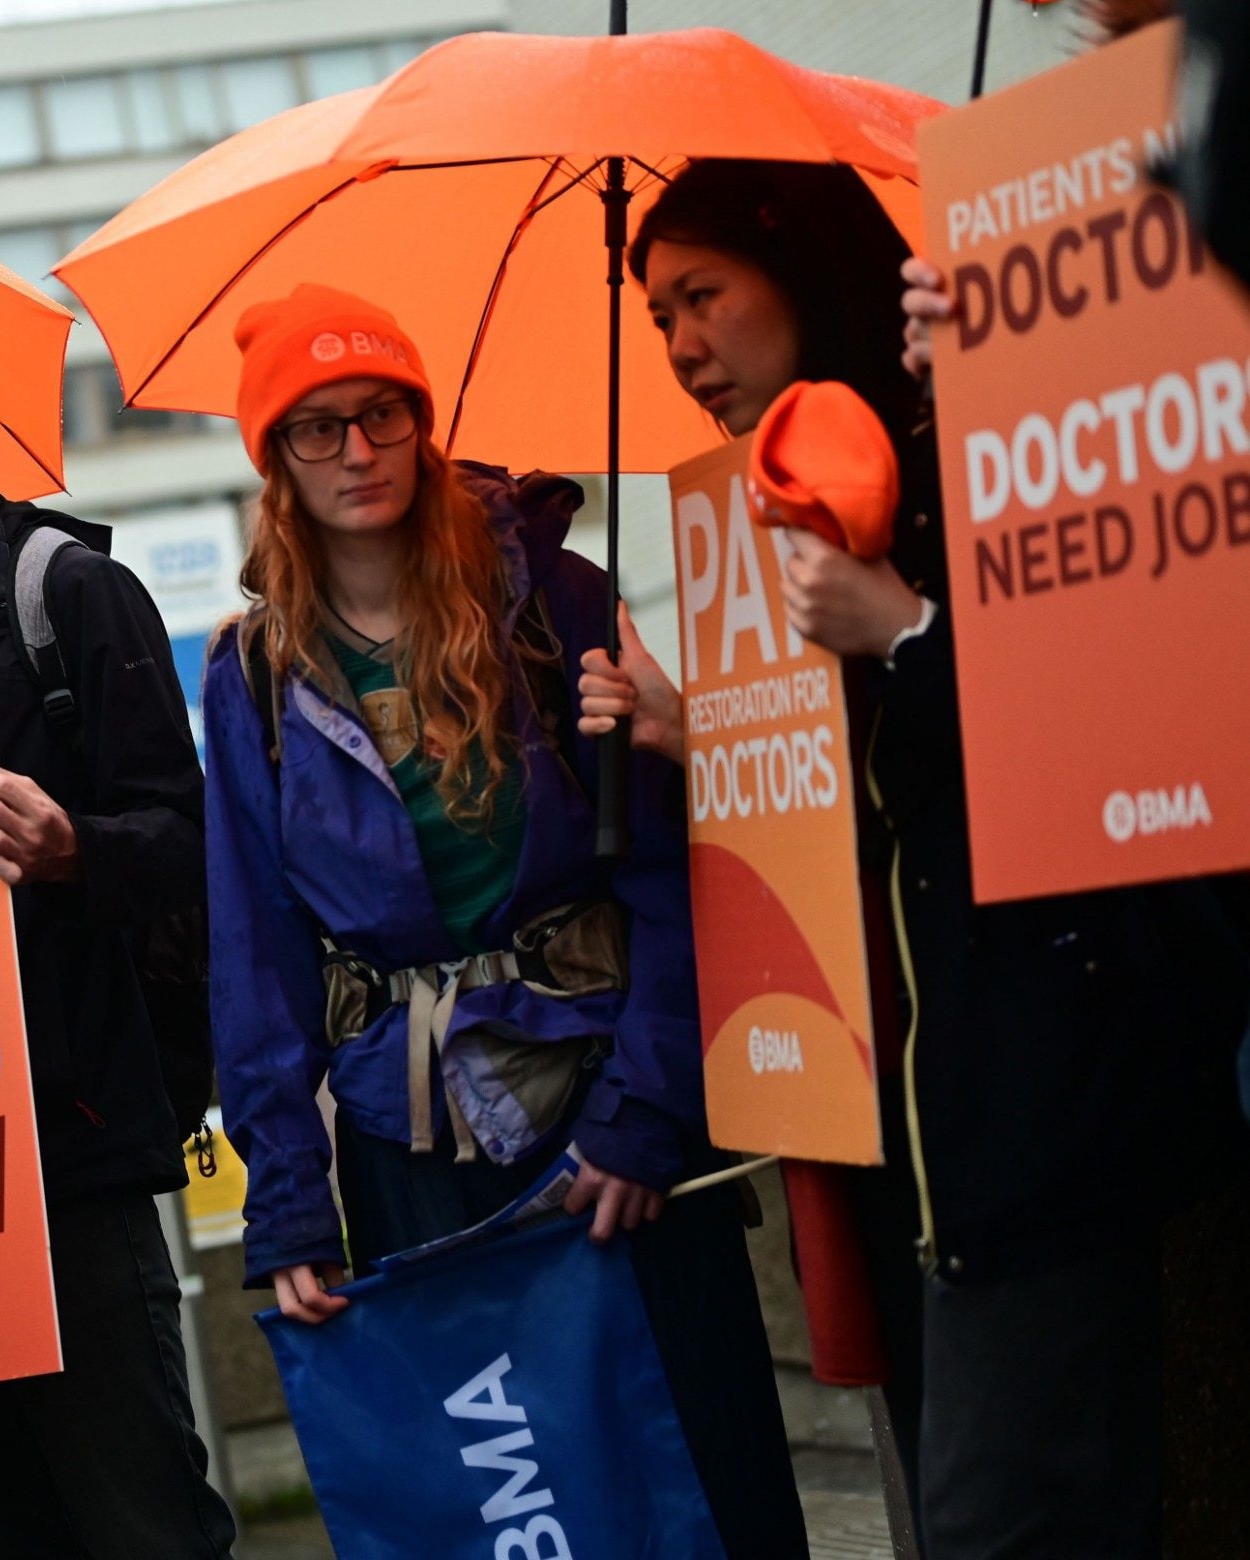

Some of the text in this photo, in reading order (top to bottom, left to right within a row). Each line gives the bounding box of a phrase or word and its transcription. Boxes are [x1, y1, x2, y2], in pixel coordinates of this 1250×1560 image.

[946, 138, 1138, 252] PATIENTS
[955, 192, 1205, 351] DOCTO
[964, 352, 1250, 525] DOCTOR
[975, 504, 1134, 607] NEED
[688, 666, 830, 733] RESTORATION FOR
[691, 724, 838, 822] DOCTORS
[1136, 782, 1213, 835] BMA
[763, 1029, 804, 1073] BMA
